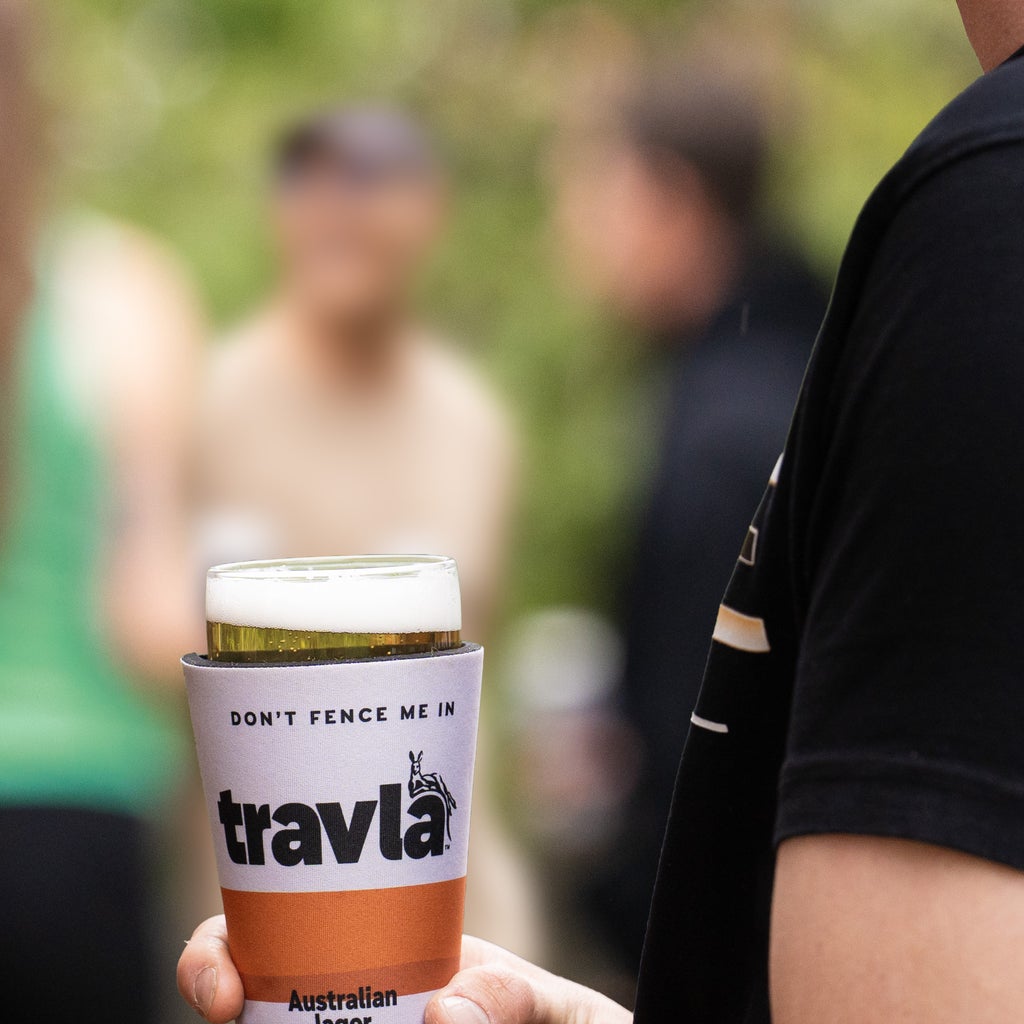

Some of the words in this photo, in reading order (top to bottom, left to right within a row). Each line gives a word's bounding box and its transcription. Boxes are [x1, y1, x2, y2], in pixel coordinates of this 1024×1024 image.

[230, 710, 297, 726] DON'T
[309, 706, 388, 725] FENCE
[399, 703, 429, 721] ME
[437, 701, 455, 717] IN
[217, 782, 445, 867] travla
[287, 985, 398, 1012] Australian
